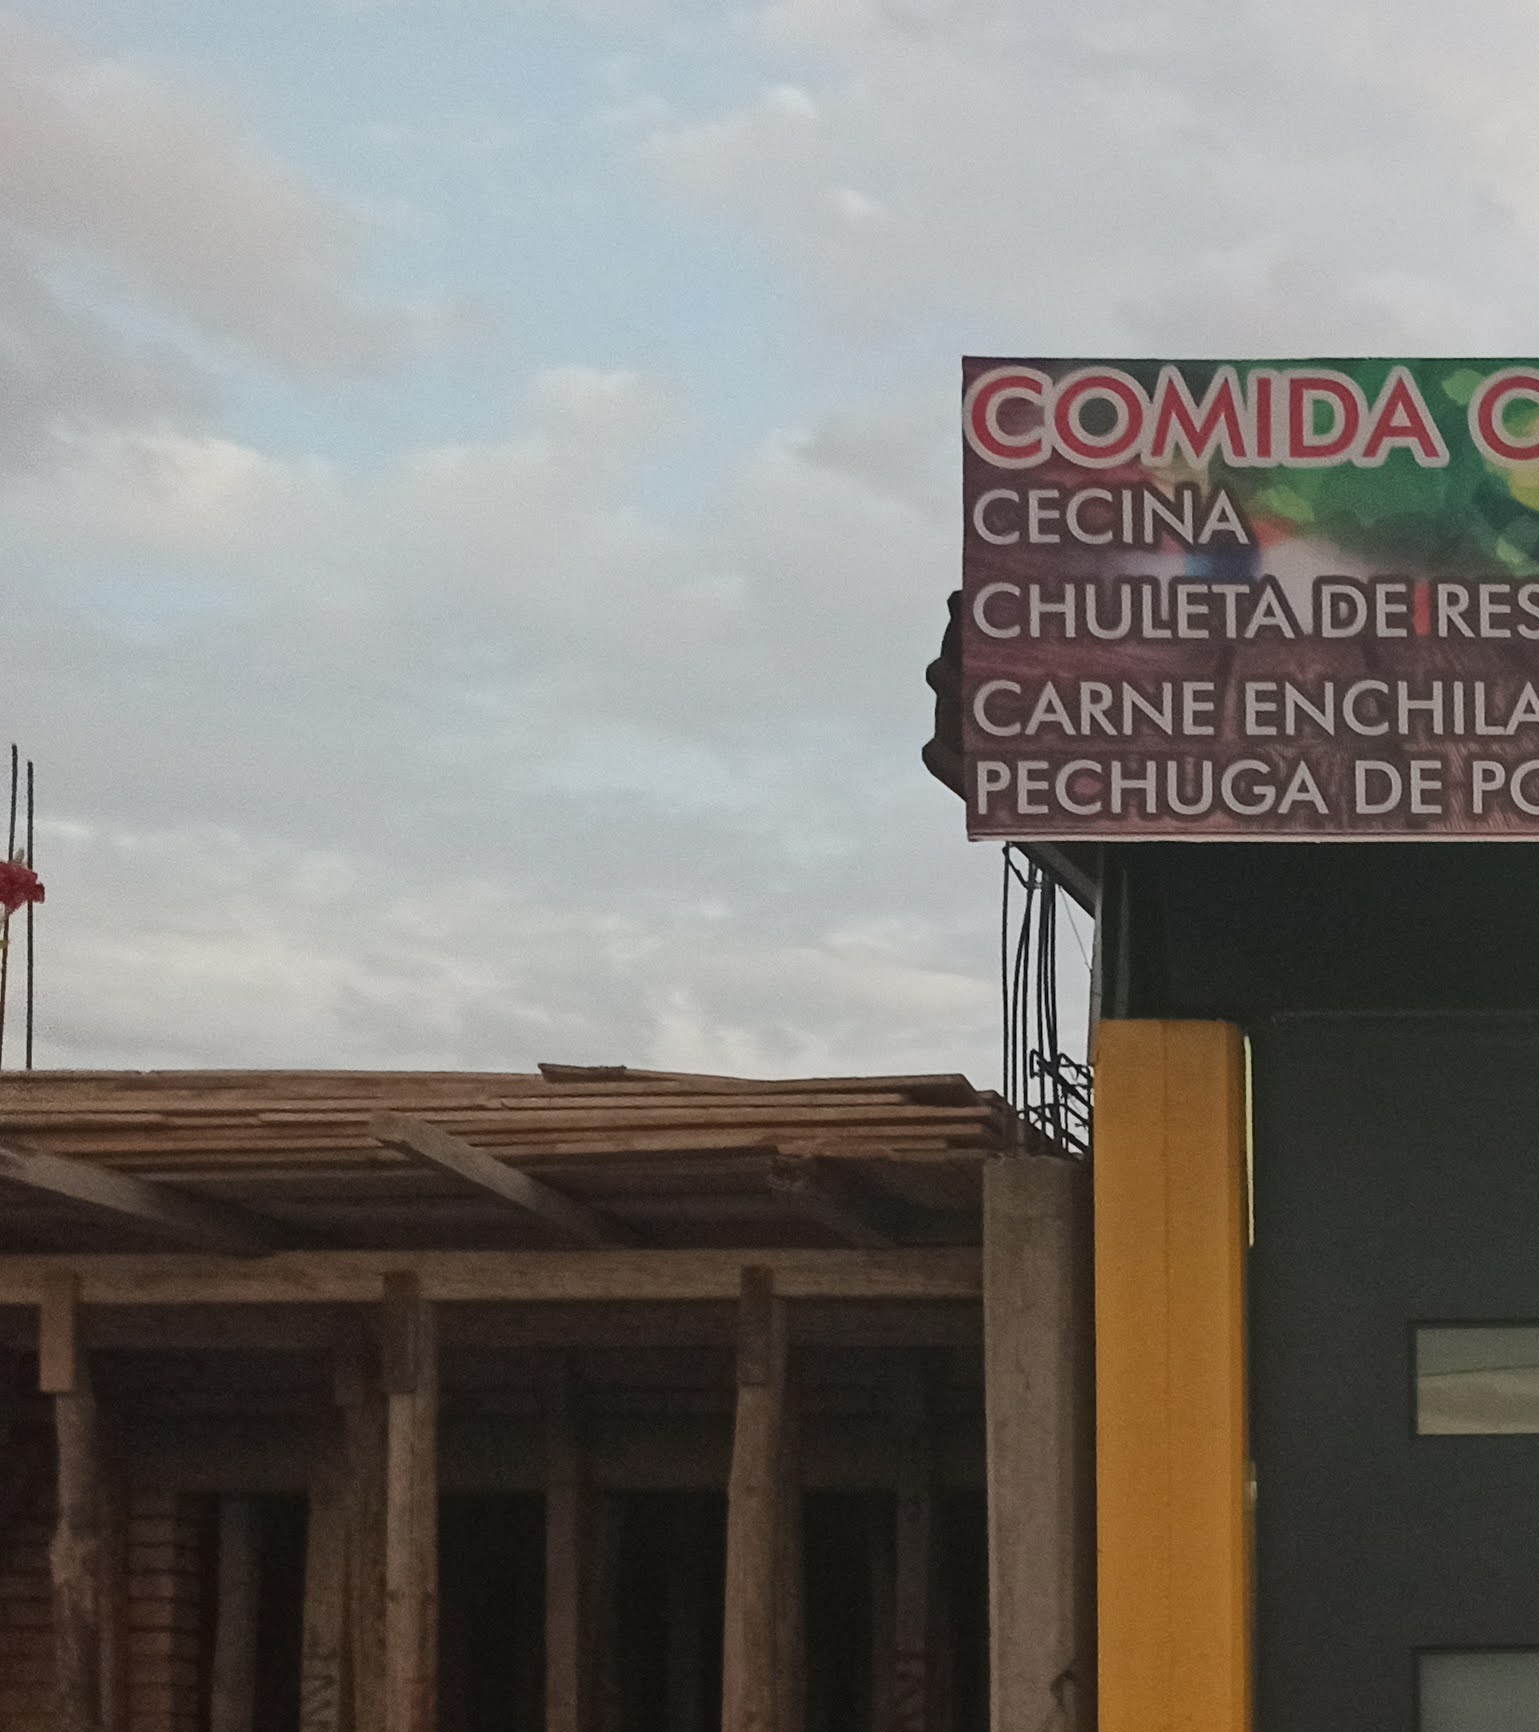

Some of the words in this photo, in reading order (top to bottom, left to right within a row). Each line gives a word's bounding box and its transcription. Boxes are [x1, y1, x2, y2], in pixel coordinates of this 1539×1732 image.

[968, 370, 1443, 465] COMIDA
[972, 487, 1249, 546] CECINA
[972, 580, 1297, 641] CHULETA
[1321, 583, 1410, 639] DE
[972, 680, 1216, 738] CARNE
[976, 760, 1331, 816] PECHUGA
[1355, 760, 1443, 816] DE
